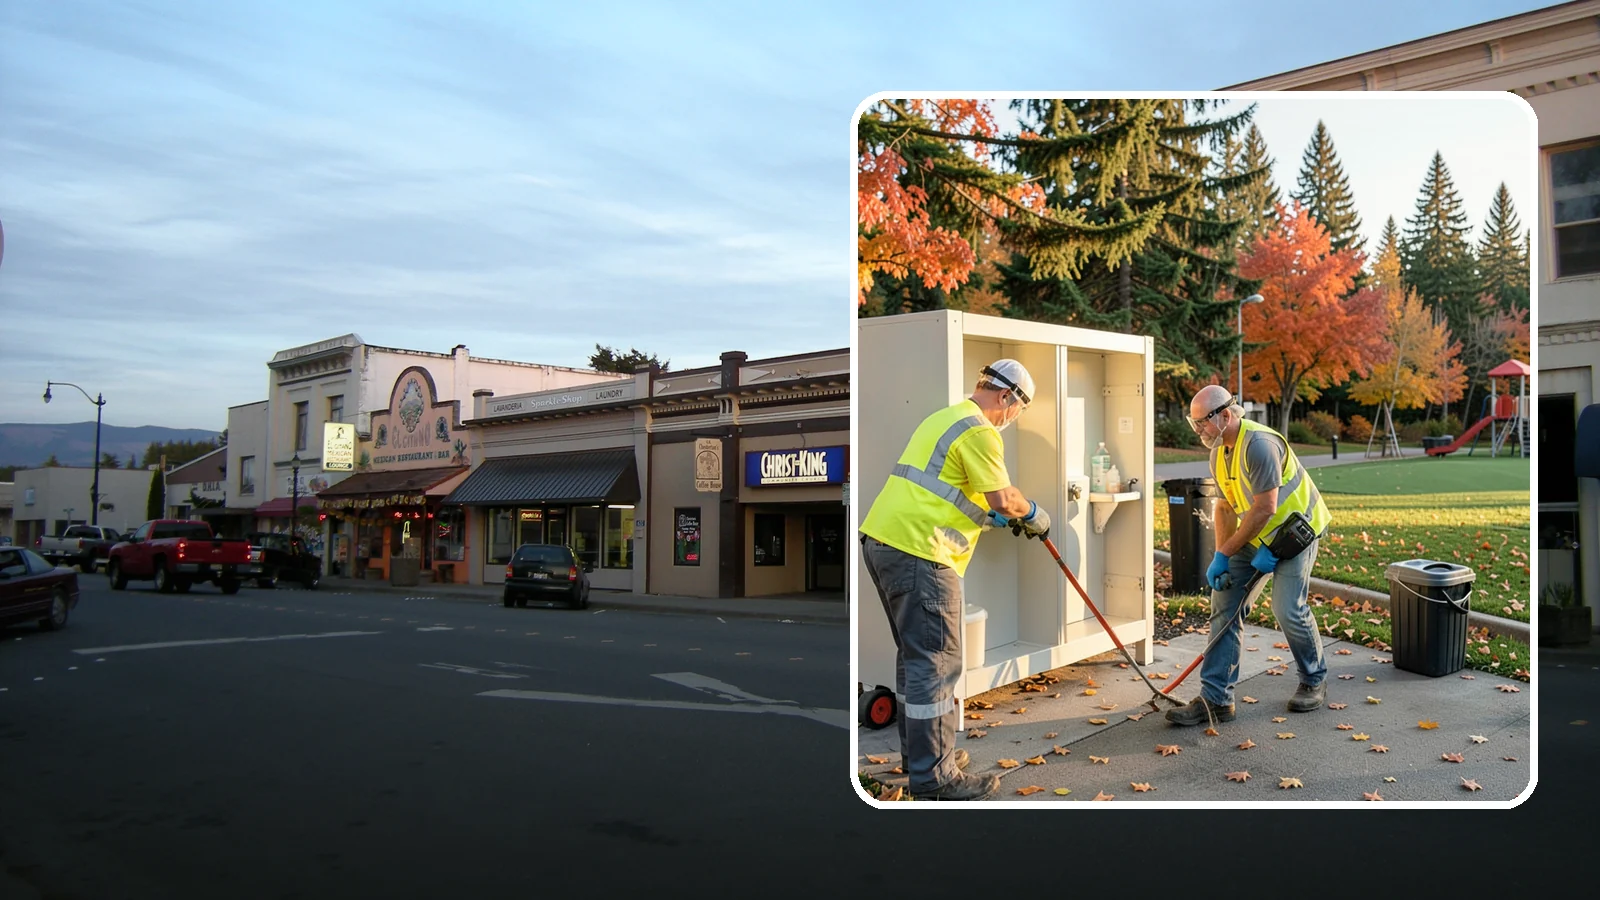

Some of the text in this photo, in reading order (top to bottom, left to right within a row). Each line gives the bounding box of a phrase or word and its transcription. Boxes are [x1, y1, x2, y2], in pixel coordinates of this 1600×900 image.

[595, 389, 623, 400] LAUNDRY
[493, 402, 522, 412] LAVANDERIA
[530, 394, 582, 408] Sparkle Shop
[397, 451, 433, 462] RESTAURANT
[438, 450, 449, 459] BAR
[761, 450, 827, 478] CHRIST KING
